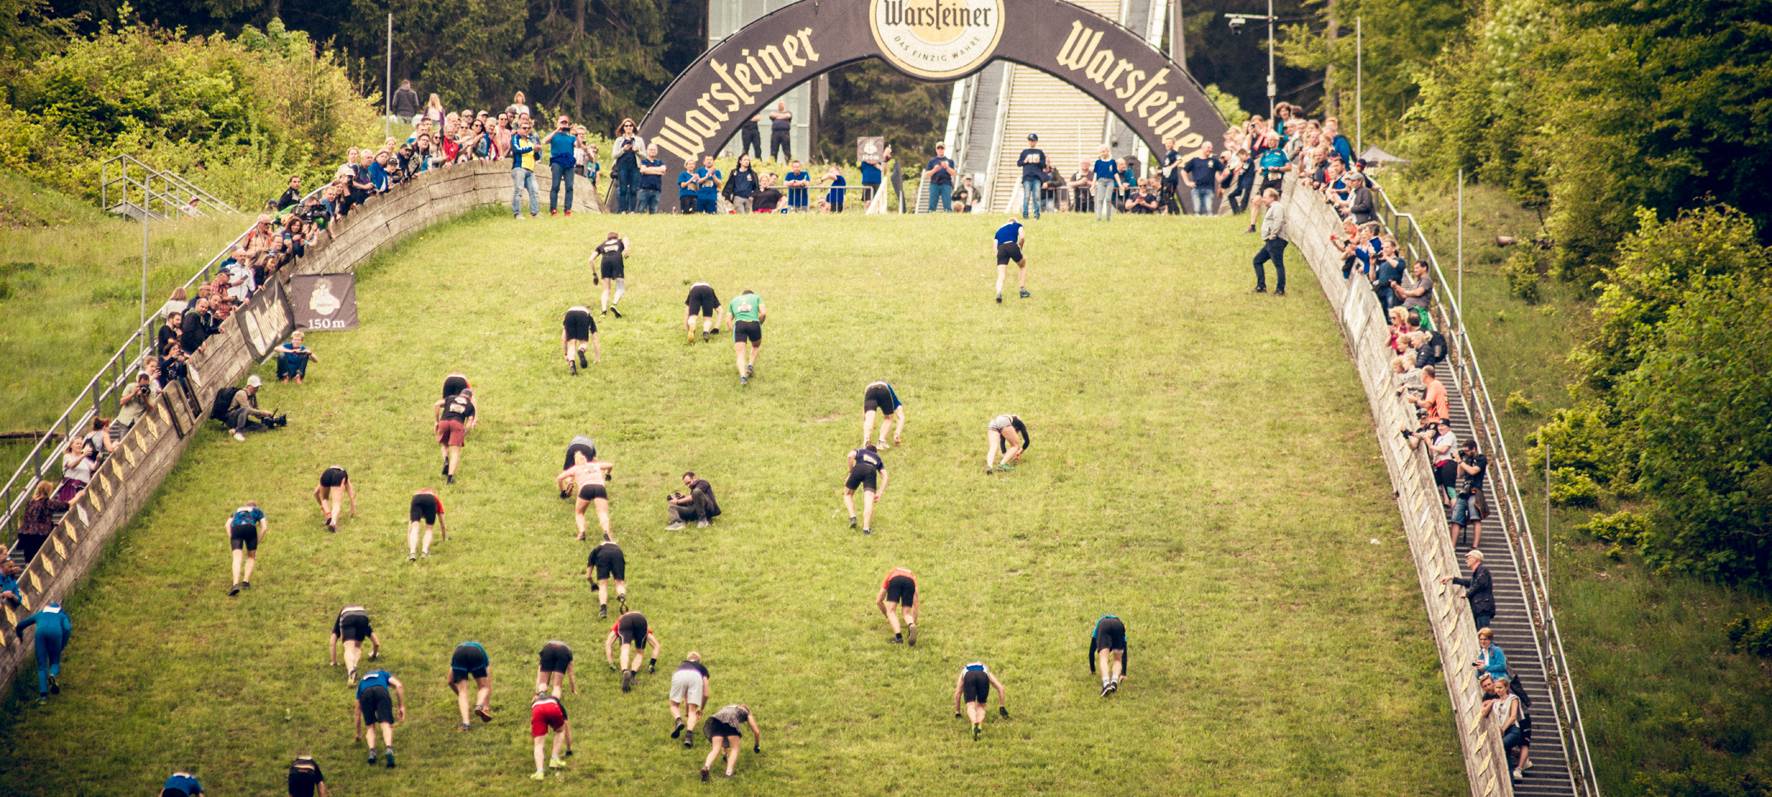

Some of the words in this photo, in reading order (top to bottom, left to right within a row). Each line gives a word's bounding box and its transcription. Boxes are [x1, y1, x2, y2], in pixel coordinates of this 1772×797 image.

[884, 0, 992, 30] Warsteiner
[894, 35, 910, 51] DAS
[912, 50, 948, 62] EINZIG
[651, 27, 820, 162] Warsteiner
